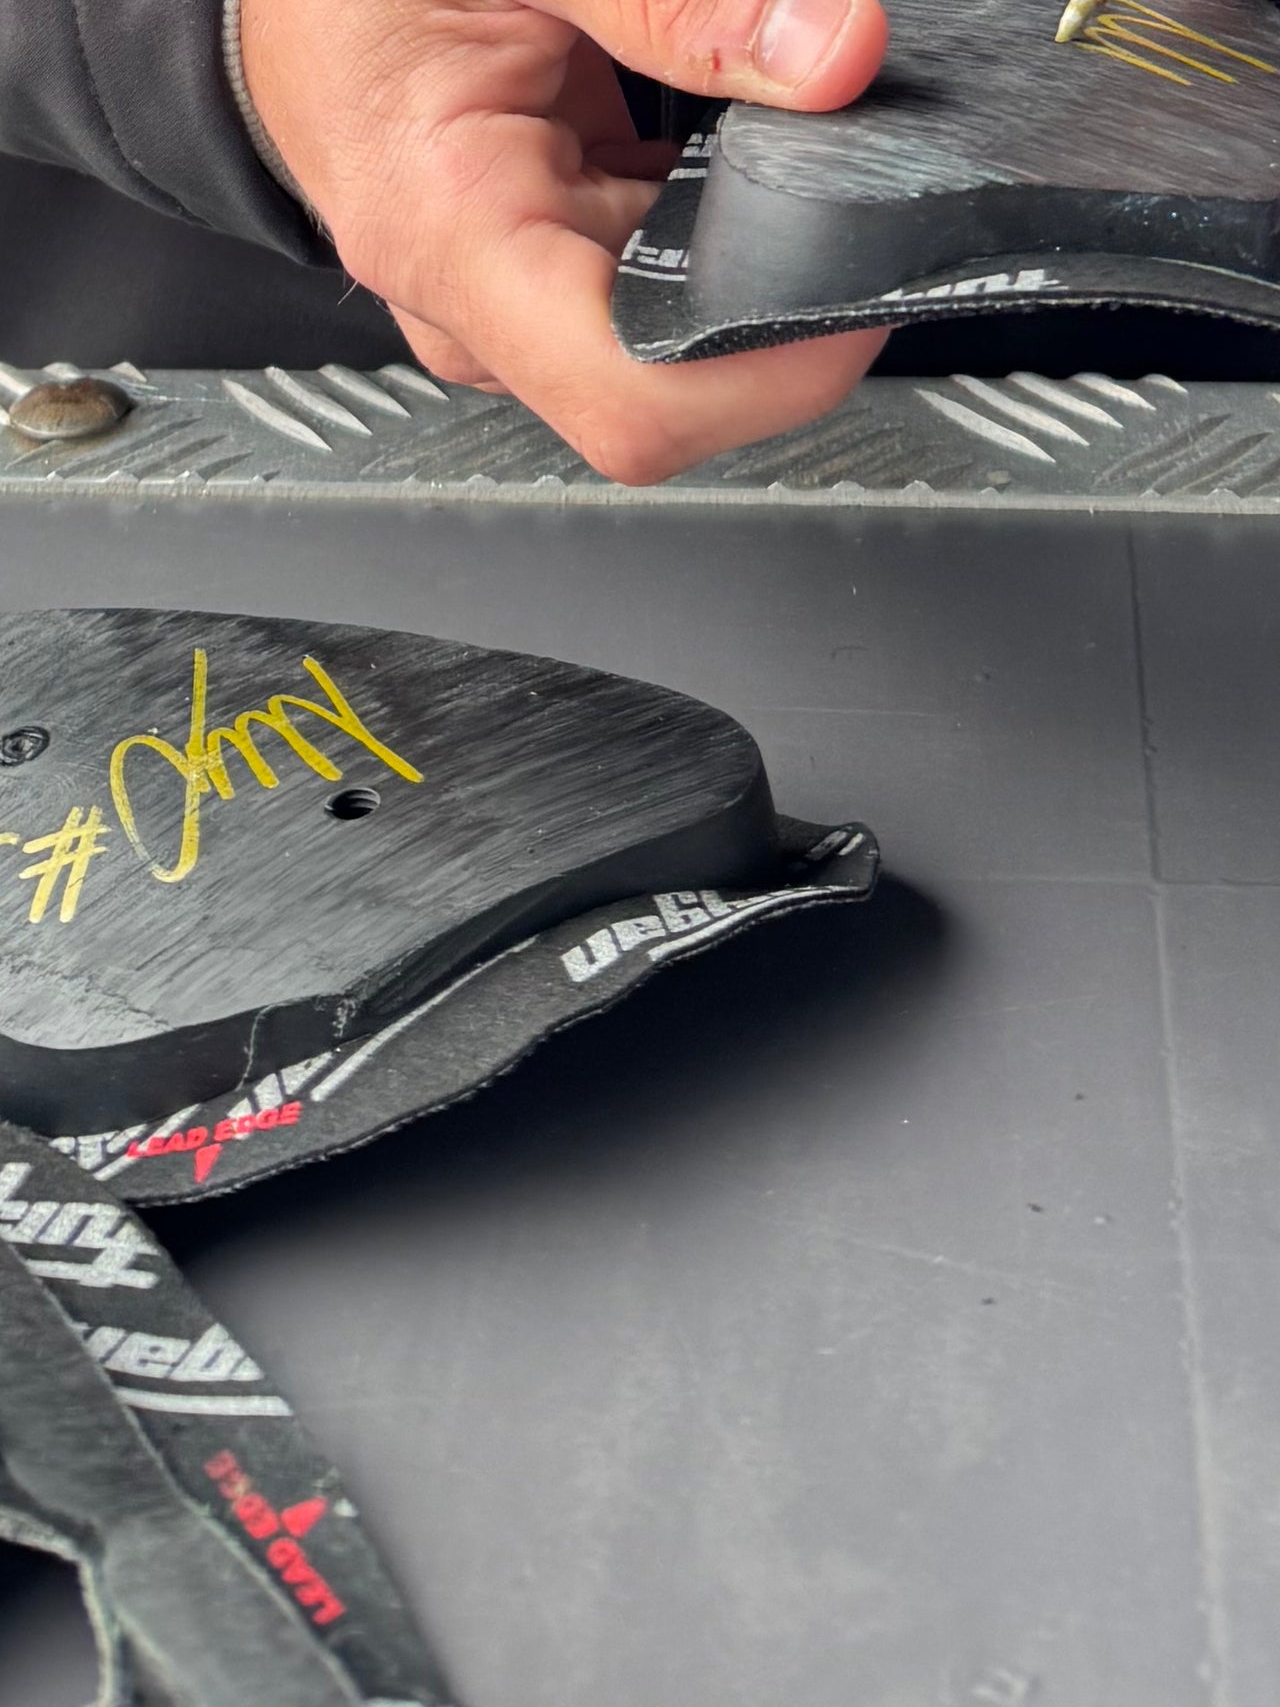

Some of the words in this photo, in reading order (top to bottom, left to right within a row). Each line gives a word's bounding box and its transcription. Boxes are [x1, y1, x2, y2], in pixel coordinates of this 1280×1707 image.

[125, 1126, 209, 1159] LEAD
[214, 1101, 303, 1142] EDGE
[204, 1450, 279, 1540] EDGE
[266, 1537, 346, 1625] LEAD
